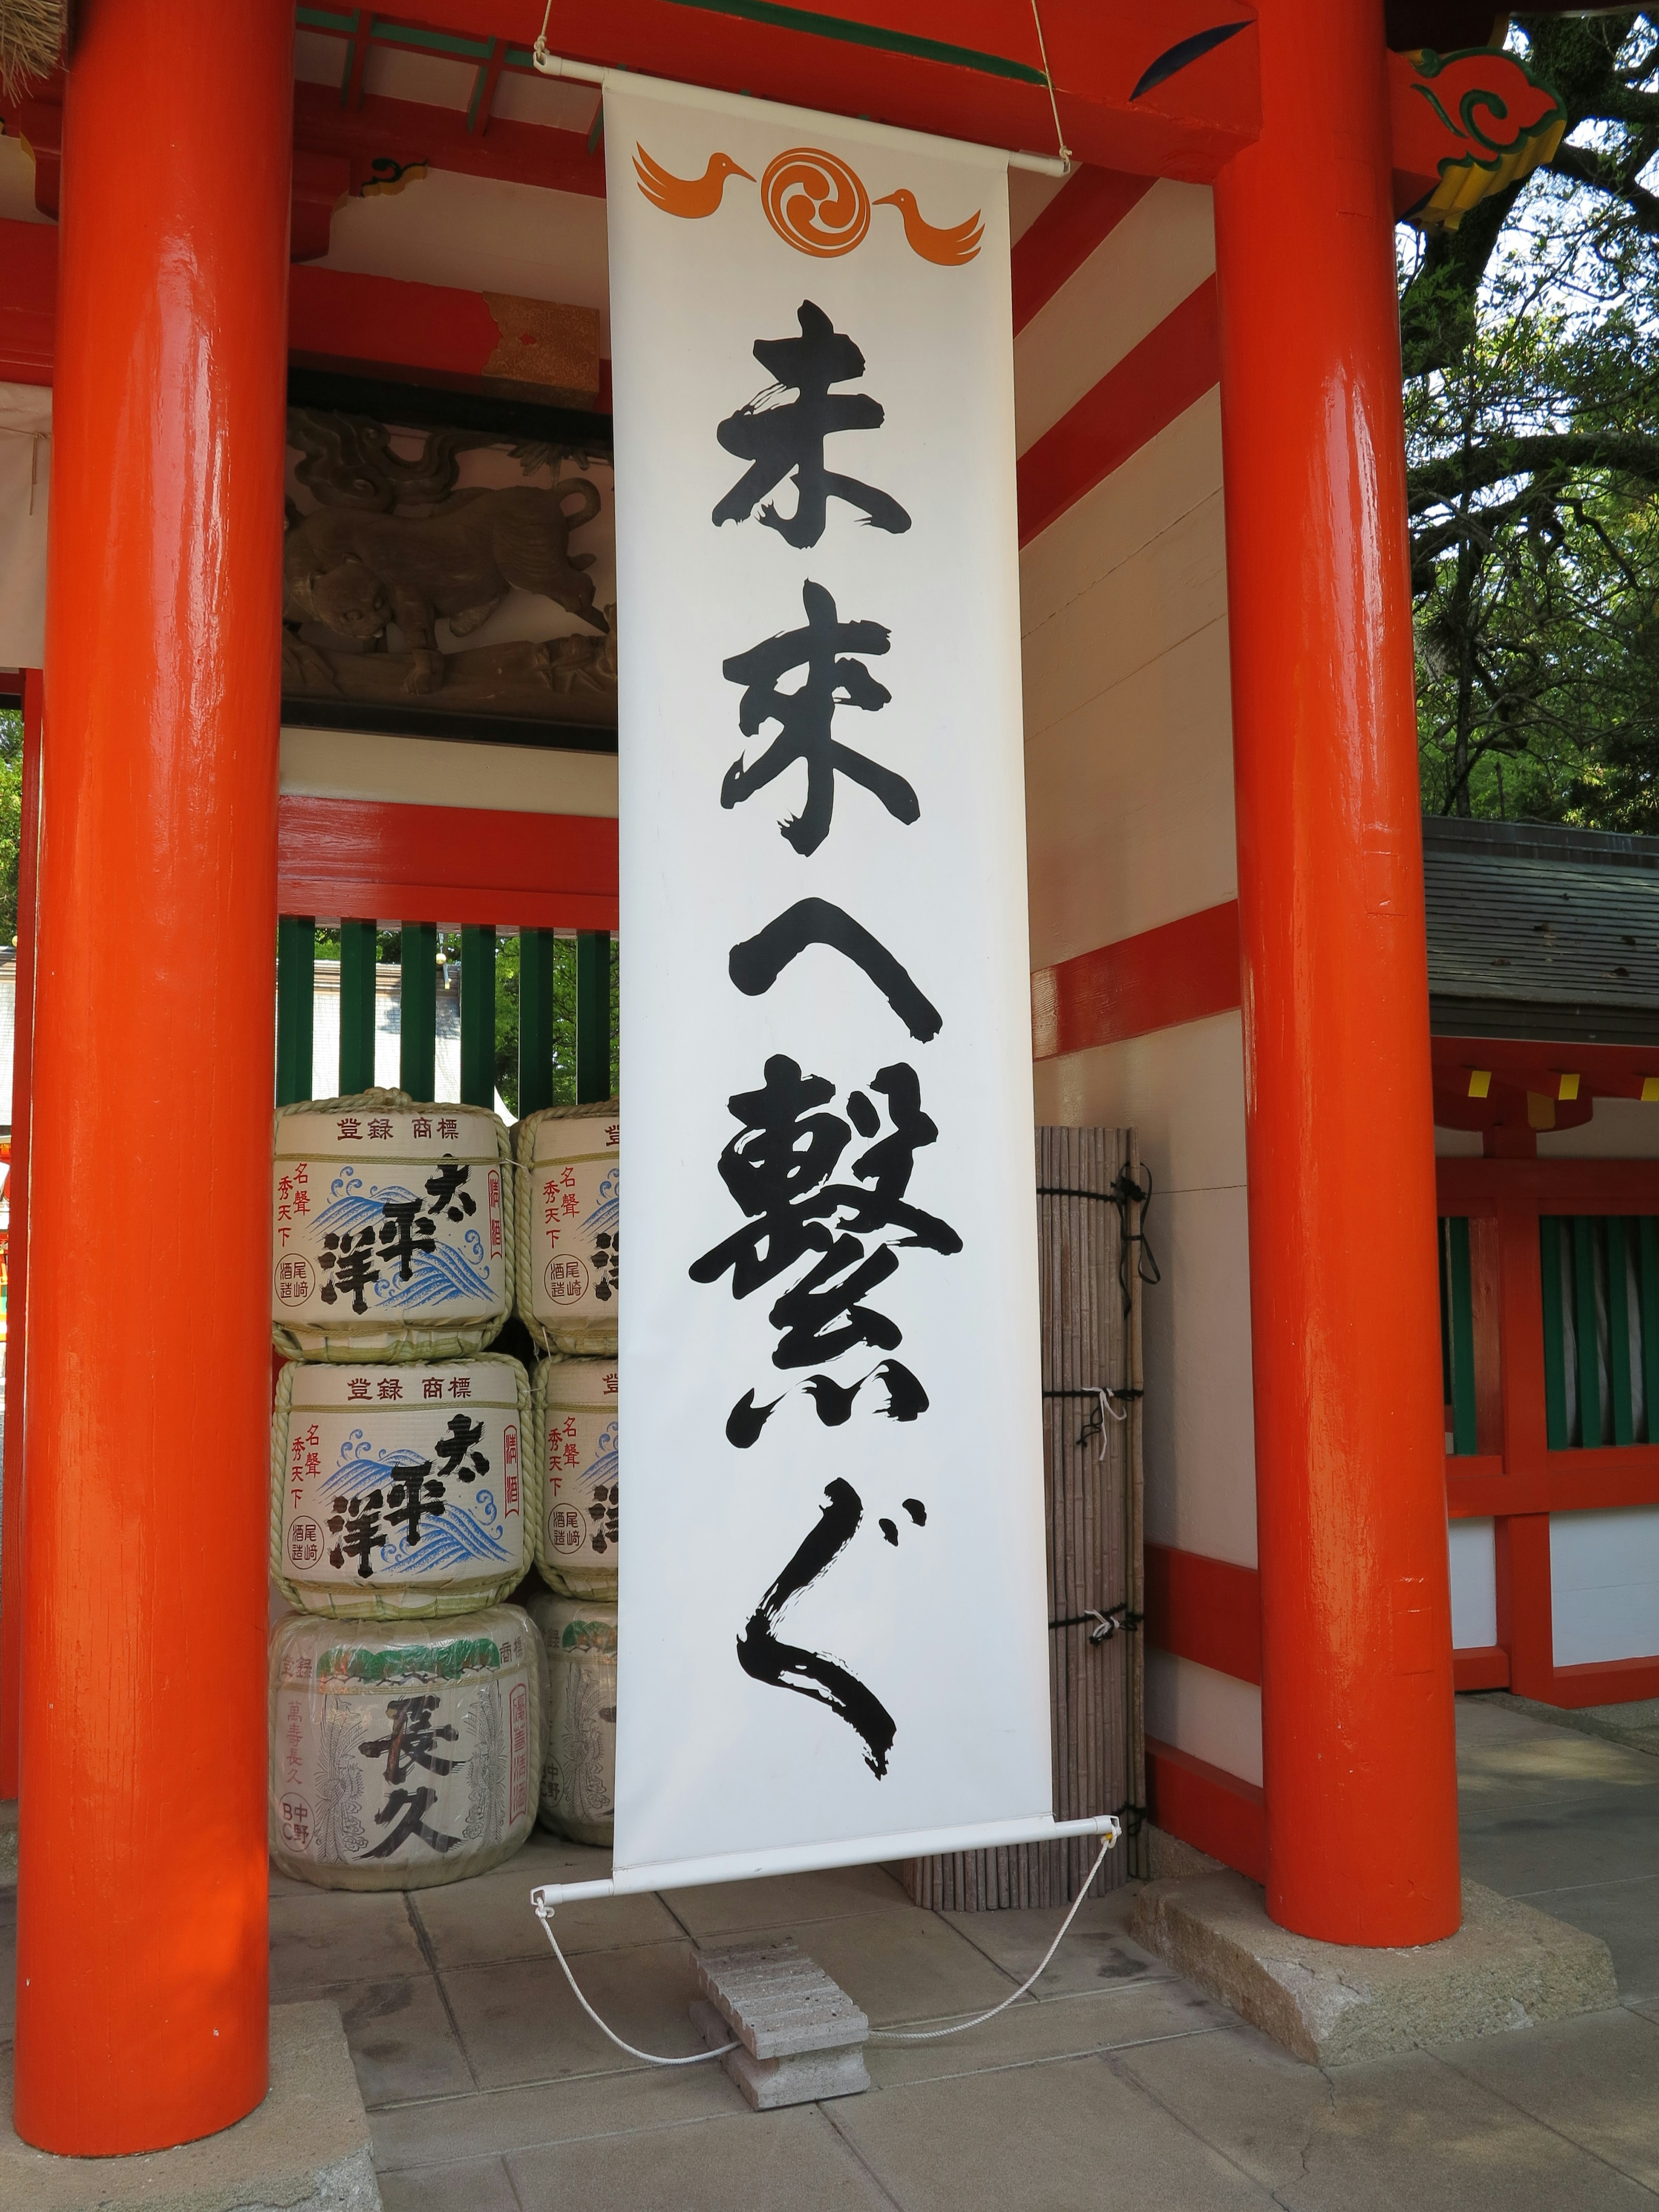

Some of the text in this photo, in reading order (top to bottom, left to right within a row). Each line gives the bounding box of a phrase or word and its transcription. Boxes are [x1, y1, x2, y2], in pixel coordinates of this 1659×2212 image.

[688, 299, 963, 1781] 未来へ繋ぐ
[315, 1153, 477, 1315] 太平洋
[324, 1414, 490, 1578] 太平洋
[281, 1654, 312, 1679] 登録
[353, 1694, 471, 1861] 長久
